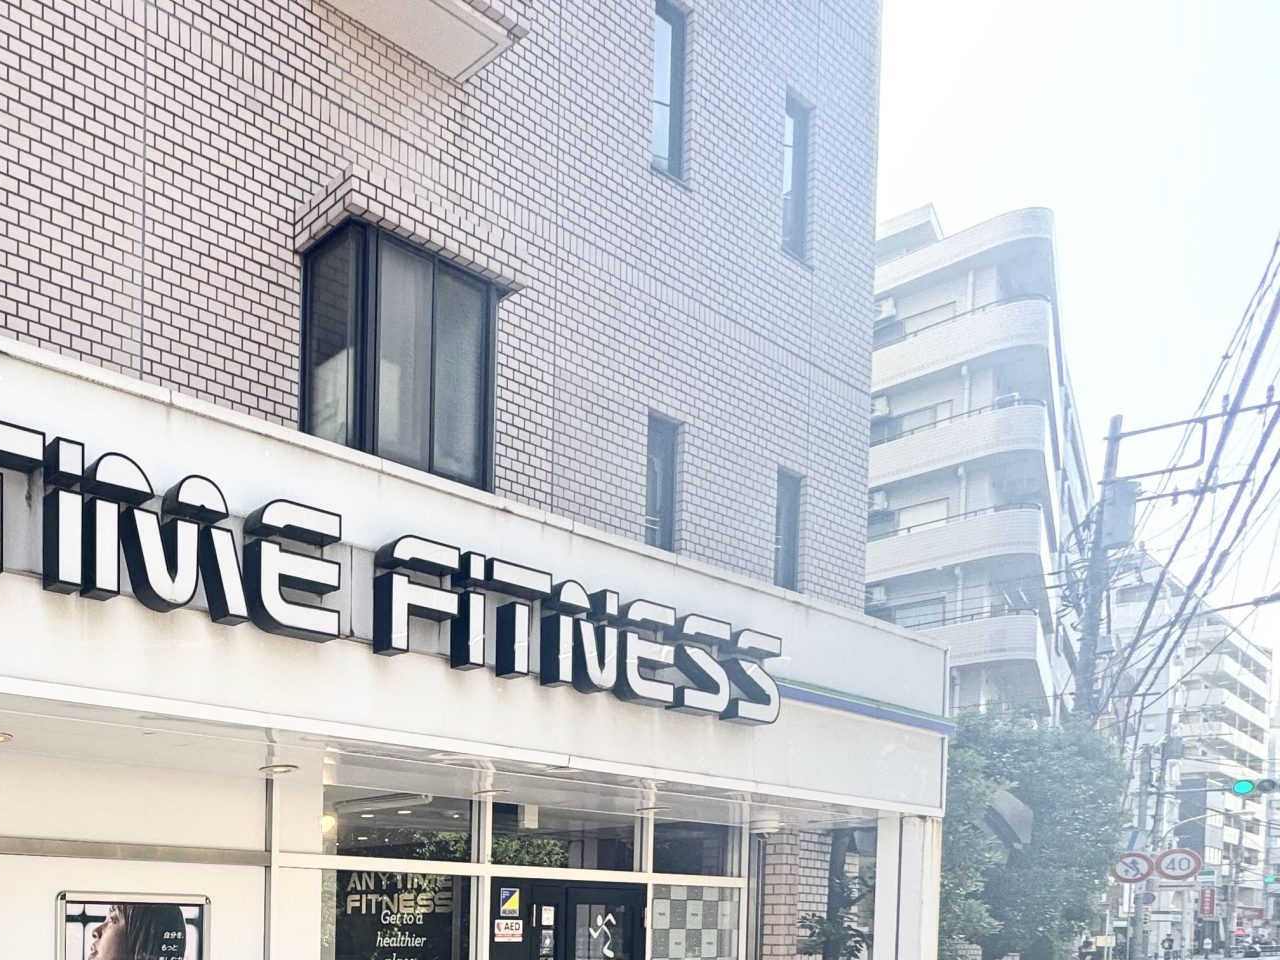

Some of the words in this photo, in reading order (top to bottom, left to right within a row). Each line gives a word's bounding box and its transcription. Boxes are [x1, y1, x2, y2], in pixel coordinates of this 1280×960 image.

[373, 534, 783, 726] FITNESS
[1166, 857, 1191, 872] 40
[346, 891, 453, 914] FITNESS
[380, 909, 401, 925] Get
[402, 911, 415, 924] to
[504, 921, 521, 931] AED
[161, 943, 178, 951] もっと
[375, 931, 428, 948] healthier
